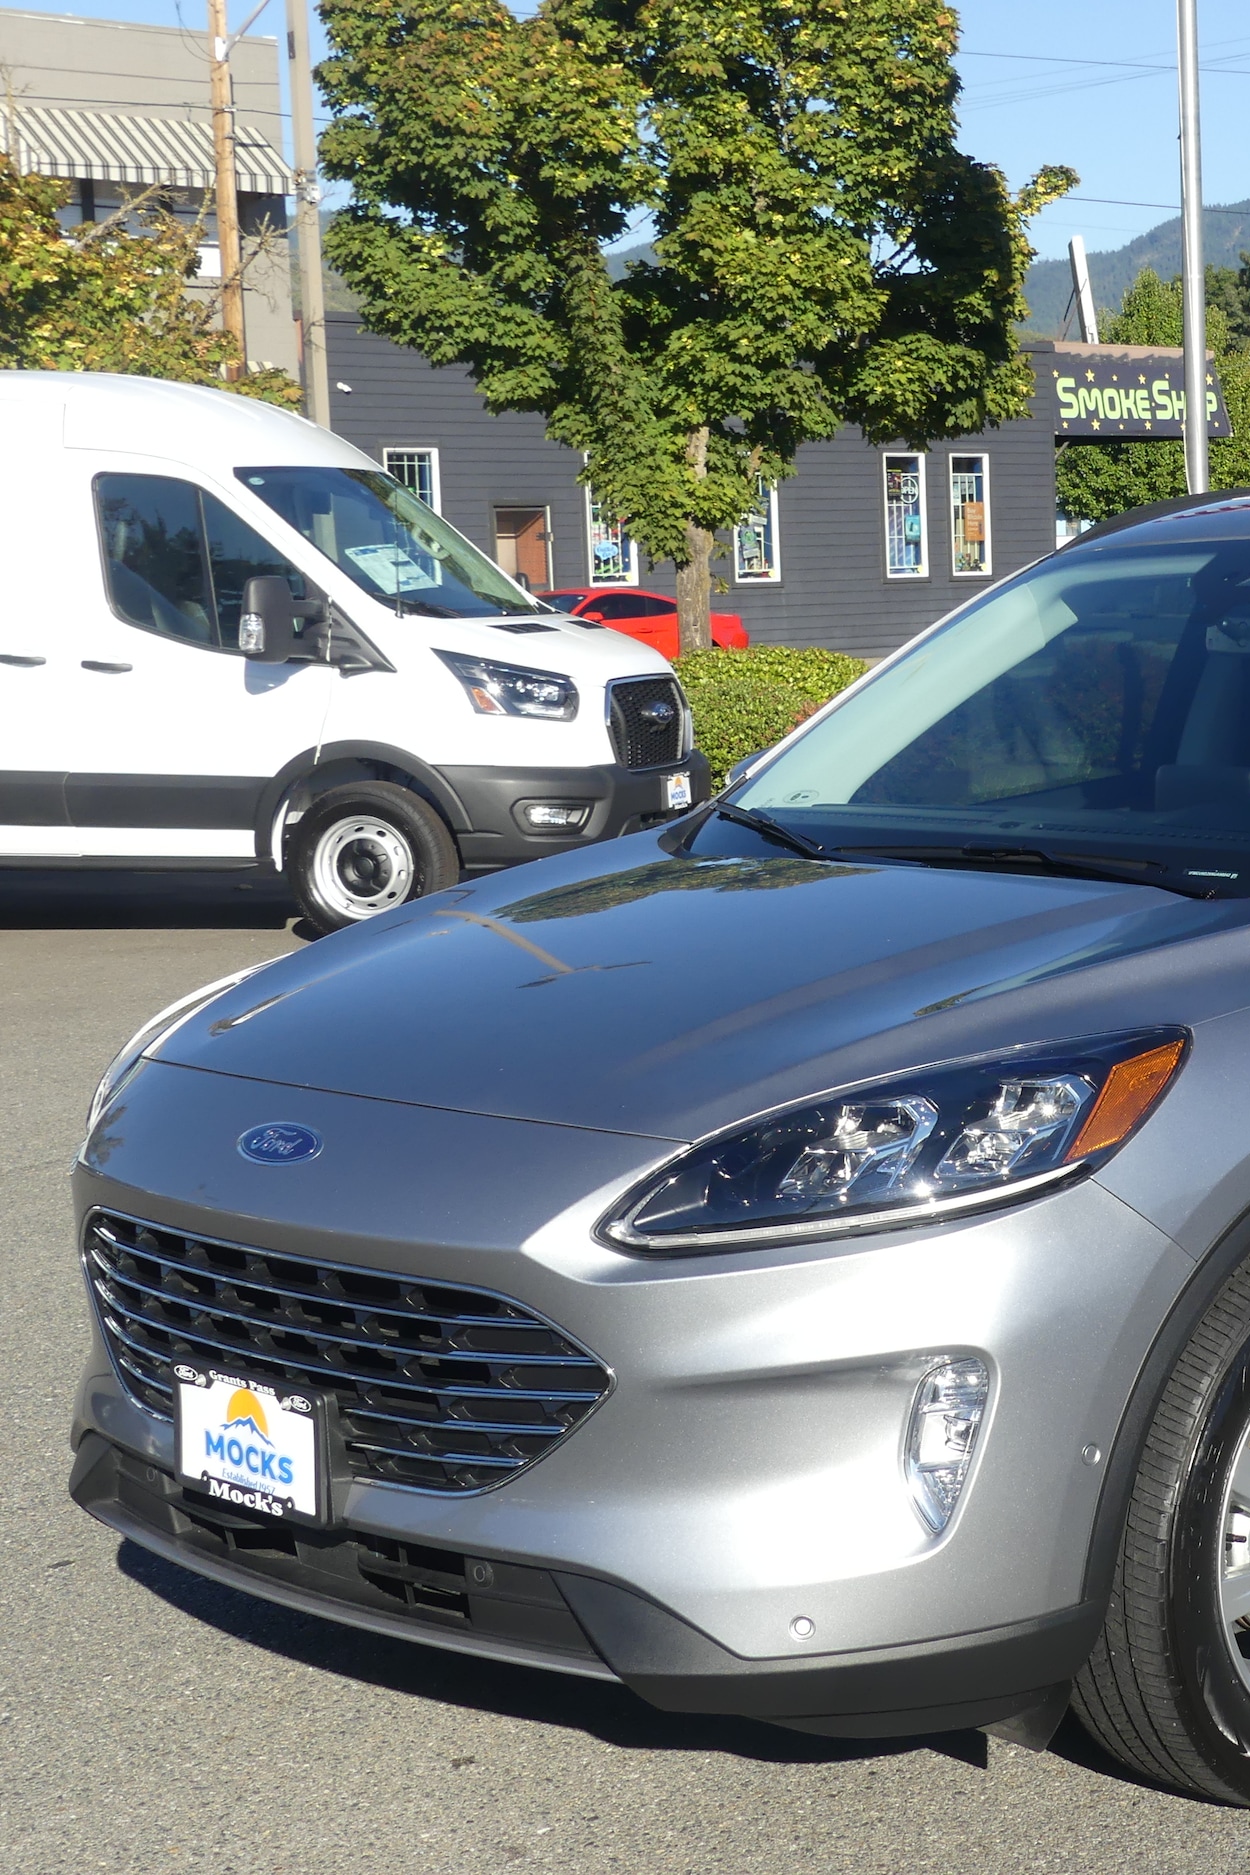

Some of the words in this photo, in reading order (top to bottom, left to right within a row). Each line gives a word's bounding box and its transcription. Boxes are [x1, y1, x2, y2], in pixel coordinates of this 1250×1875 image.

[1056, 377, 1151, 420] SMOKE
[1152, 379, 1218, 421] SHP
[250, 1127, 303, 1155] Ford
[208, 1369, 247, 1389] Grants
[248, 1380, 276, 1397] Pass
[204, 1430, 294, 1485] MOCKS
[208, 1478, 284, 1517] Mock's
